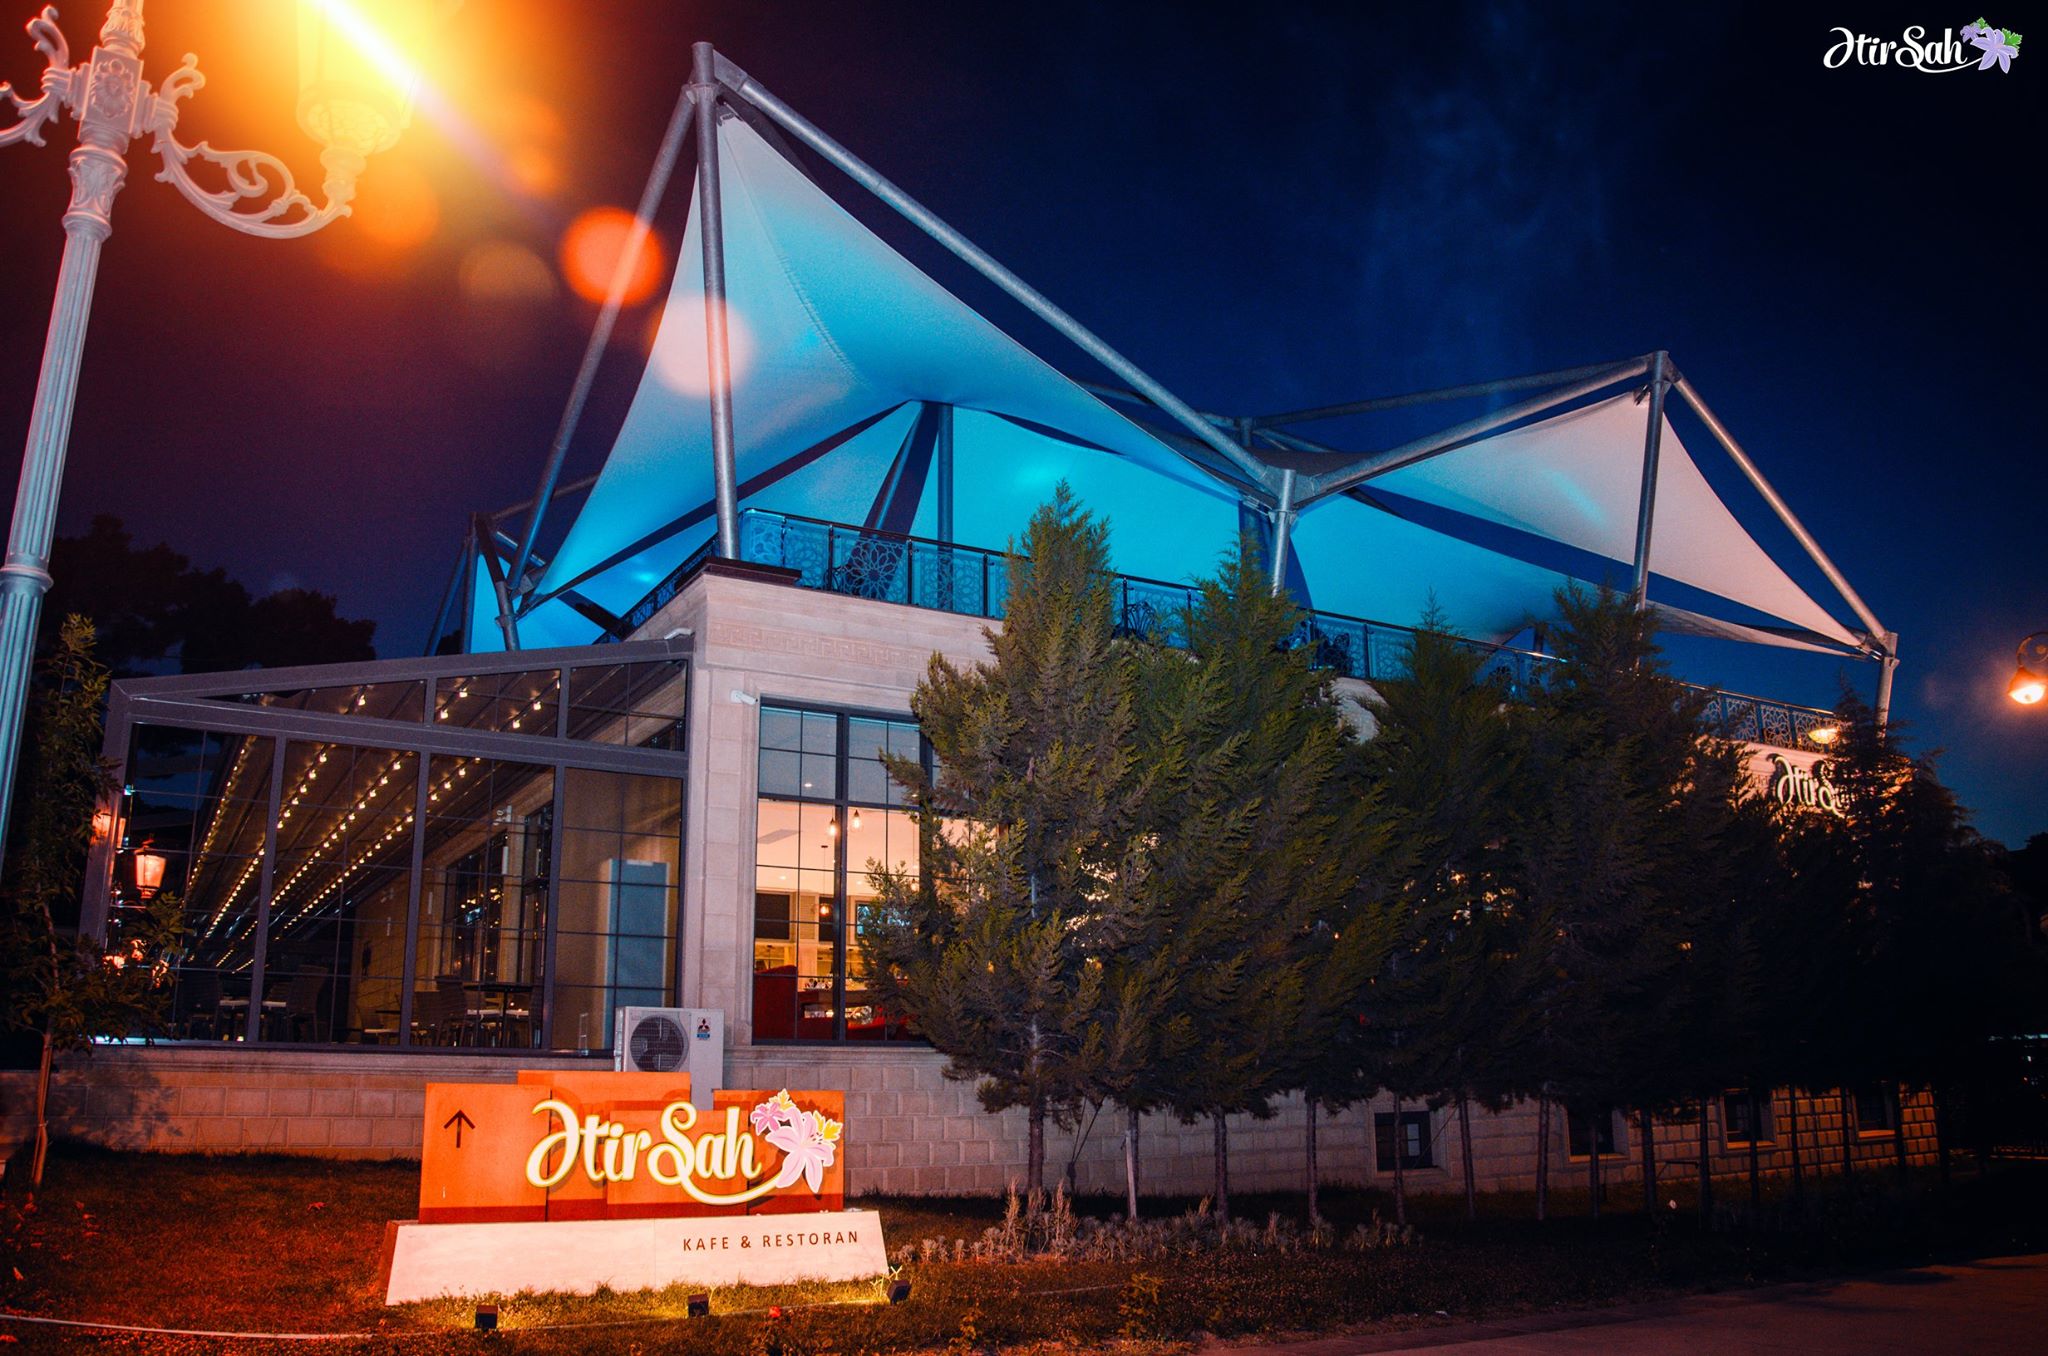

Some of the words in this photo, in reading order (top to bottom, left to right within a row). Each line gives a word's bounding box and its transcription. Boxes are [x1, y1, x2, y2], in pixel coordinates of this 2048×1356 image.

[683, 1236, 729, 1251] KAFE
[740, 1235, 751, 1249] &
[762, 1230, 858, 1247] RESTORAN
